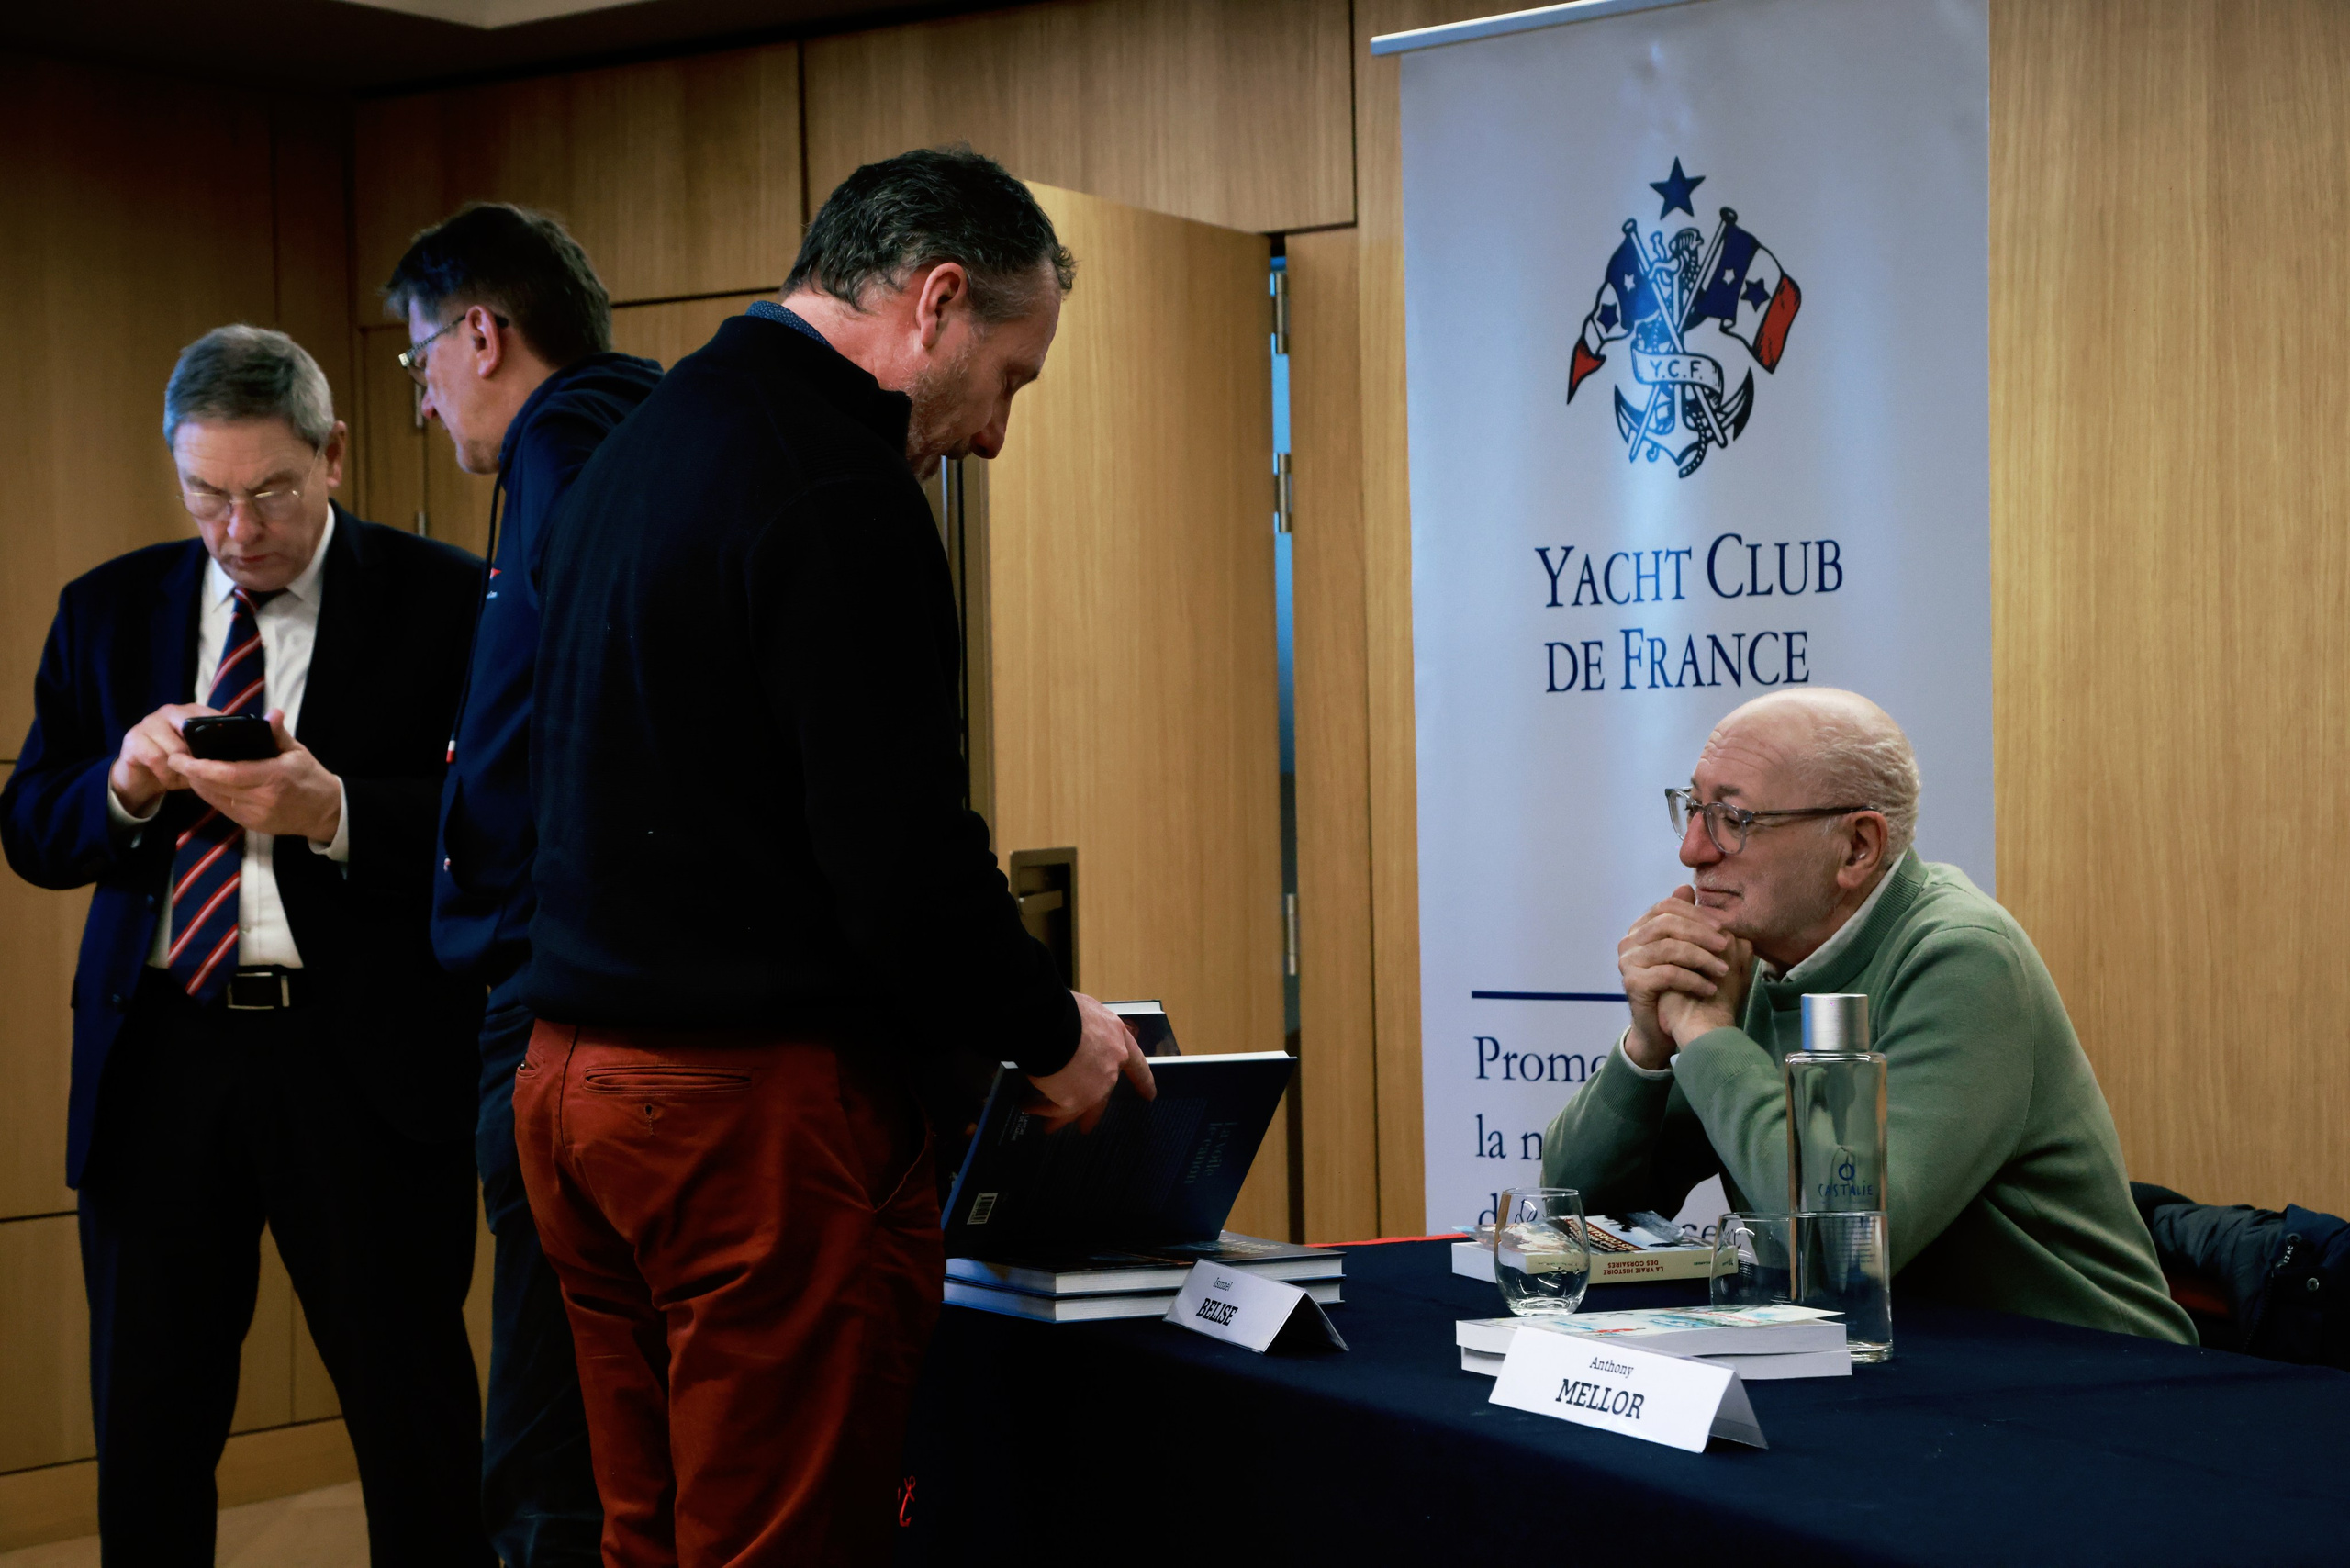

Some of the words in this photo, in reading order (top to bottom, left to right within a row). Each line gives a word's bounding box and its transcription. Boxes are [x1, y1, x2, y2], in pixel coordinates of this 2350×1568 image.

[1650, 359, 1703, 380] Y.C.F.
[1534, 545, 1693, 608] YACHT
[1707, 532, 1843, 599] CLUB
[1544, 641, 1606, 692] DE
[1619, 628, 1810, 689] FRANCE
[1475, 1114, 1507, 1159] la
[1603, 1268, 1634, 1276] HISTOIRE
[1607, 1260, 1645, 1269] CORSAIRES
[1635, 1266, 1655, 1274] VRAIE
[1195, 1297, 1239, 1327] BELISE
[1589, 1356, 1634, 1379] Anthony
[1555, 1378, 1645, 1419] MELLOR
